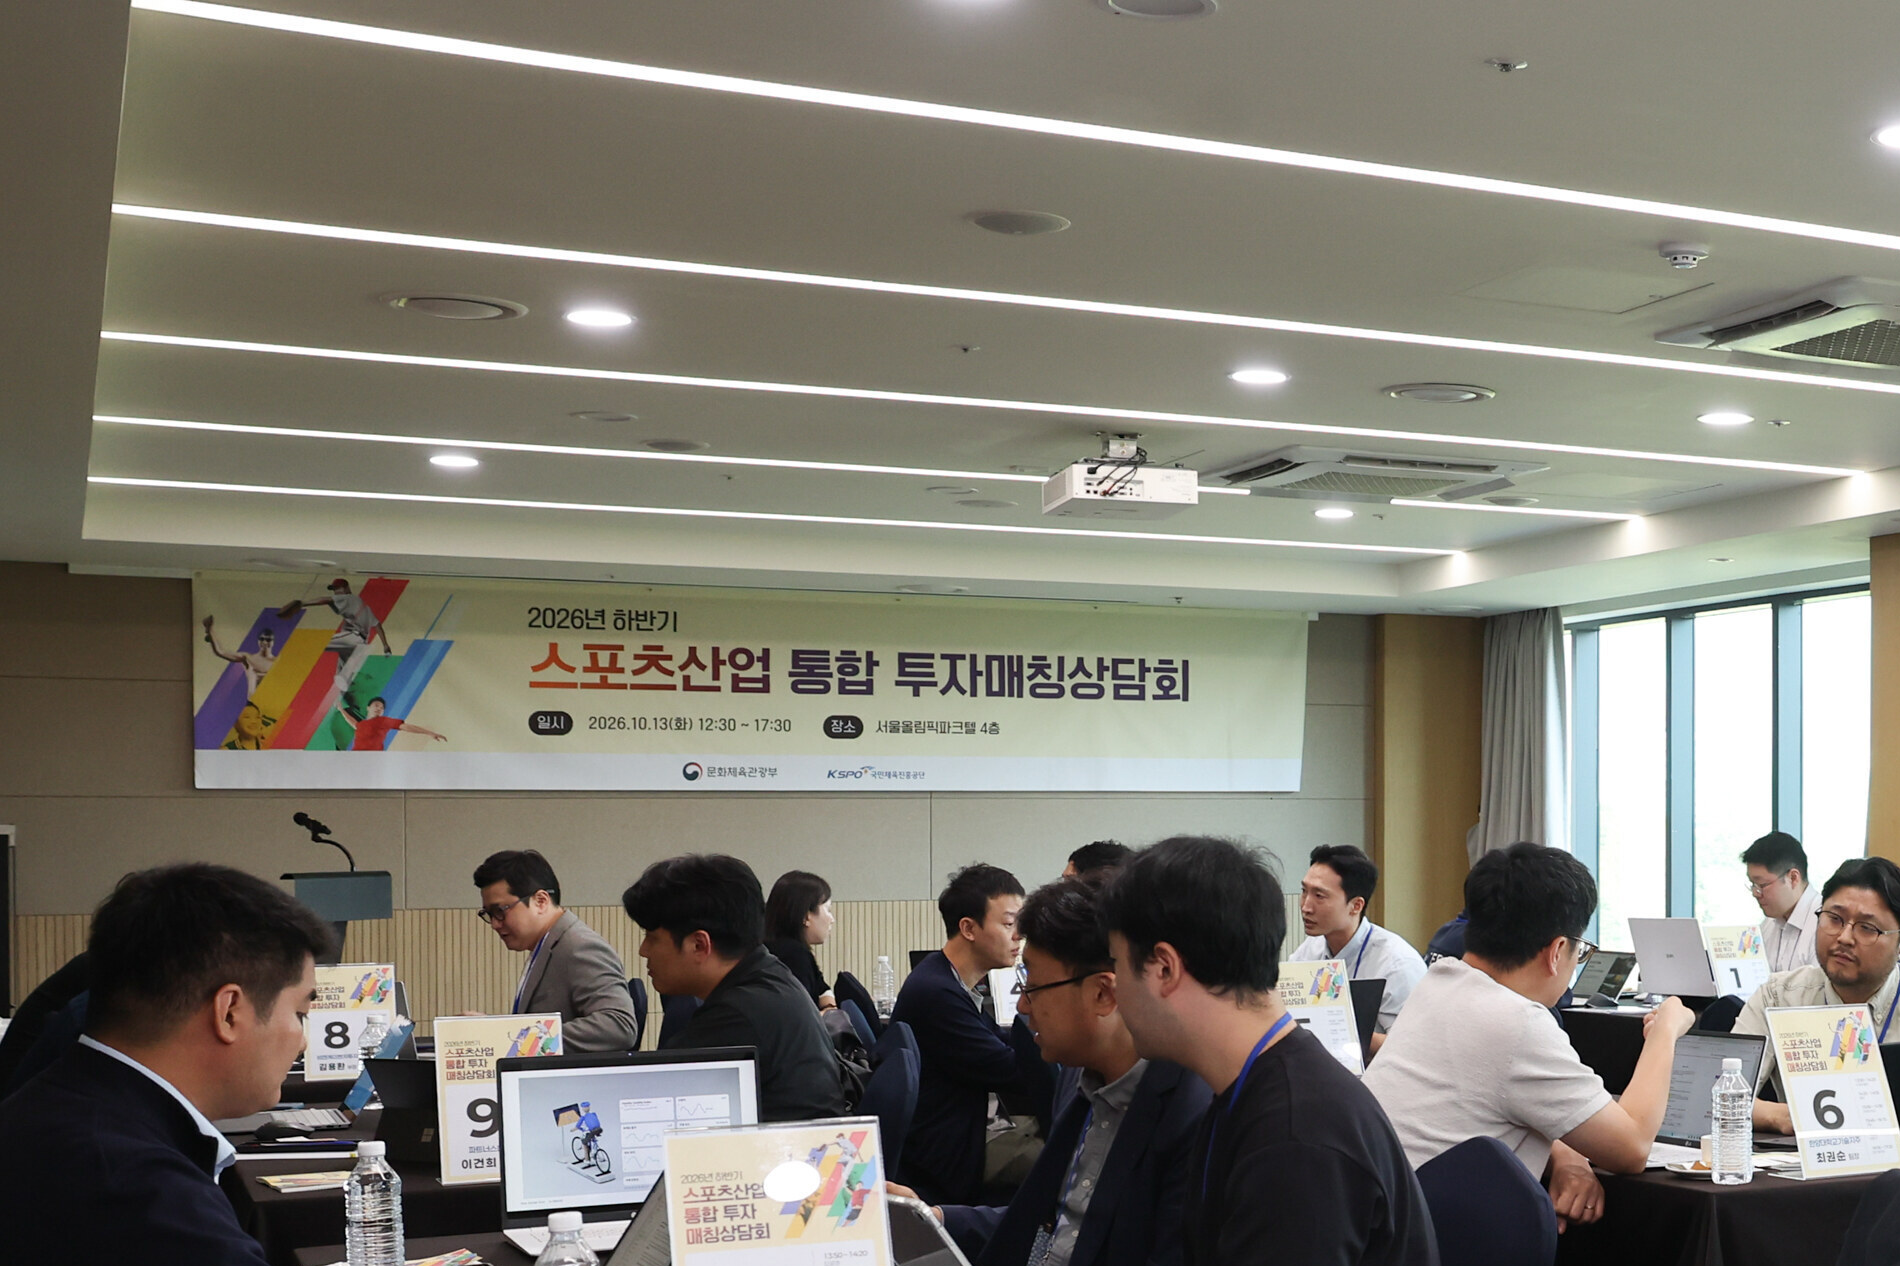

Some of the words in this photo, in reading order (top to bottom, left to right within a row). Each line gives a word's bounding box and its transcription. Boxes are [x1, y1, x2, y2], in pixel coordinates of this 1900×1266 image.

[527, 606, 606, 631] 2026년
[613, 609, 678, 632] 하반기
[529, 642, 771, 694] 스포츠산업
[788, 649, 880, 695] 통합
[894, 651, 1189, 702] 투자매칭상담회
[536, 715, 564, 730] 일시
[588, 716, 693, 731] 2026.10.13(화)
[698, 717, 736, 732] 12:30
[754, 718, 792, 733] 17:30
[831, 719, 856, 733] 장소
[875, 720, 976, 735] 서울올림픽파크텔
[979, 721, 1000, 735] 4층
[707, 766, 778, 778] 문화체육관광부
[827, 769, 863, 779] KSPO
[871, 770, 925, 780] 국민체육진흥공단
[1729, 967, 1742, 989] 1
[324, 1021, 351, 1049] 8
[1782, 1038, 1822, 1050] 스포츠산업
[445, 1047, 494, 1058] 스포츠산업
[1802, 1050, 1819, 1060] 투자
[446, 1059, 466, 1070] 통합
[468, 1058, 488, 1068] 투자
[1786, 1060, 1828, 1072] 매칭상담회
[446, 1069, 496, 1081] 매칭상담회
[1813, 1089, 1845, 1130] 6
[466, 1097, 500, 1138] 9
[468, 1145, 500, 1154] 파트너스
[1816, 1150, 1847, 1163] 최권순
[461, 1157, 497, 1170] 이건희
[680, 1173, 714, 1185] 2026년
[715, 1170, 743, 1182] 하반기
[682, 1182, 767, 1204] 스포츠산업
[684, 1206, 719, 1225] 통합
[723, 1203, 758, 1221] 투자
[686, 1222, 771, 1245] 매칭상담회
